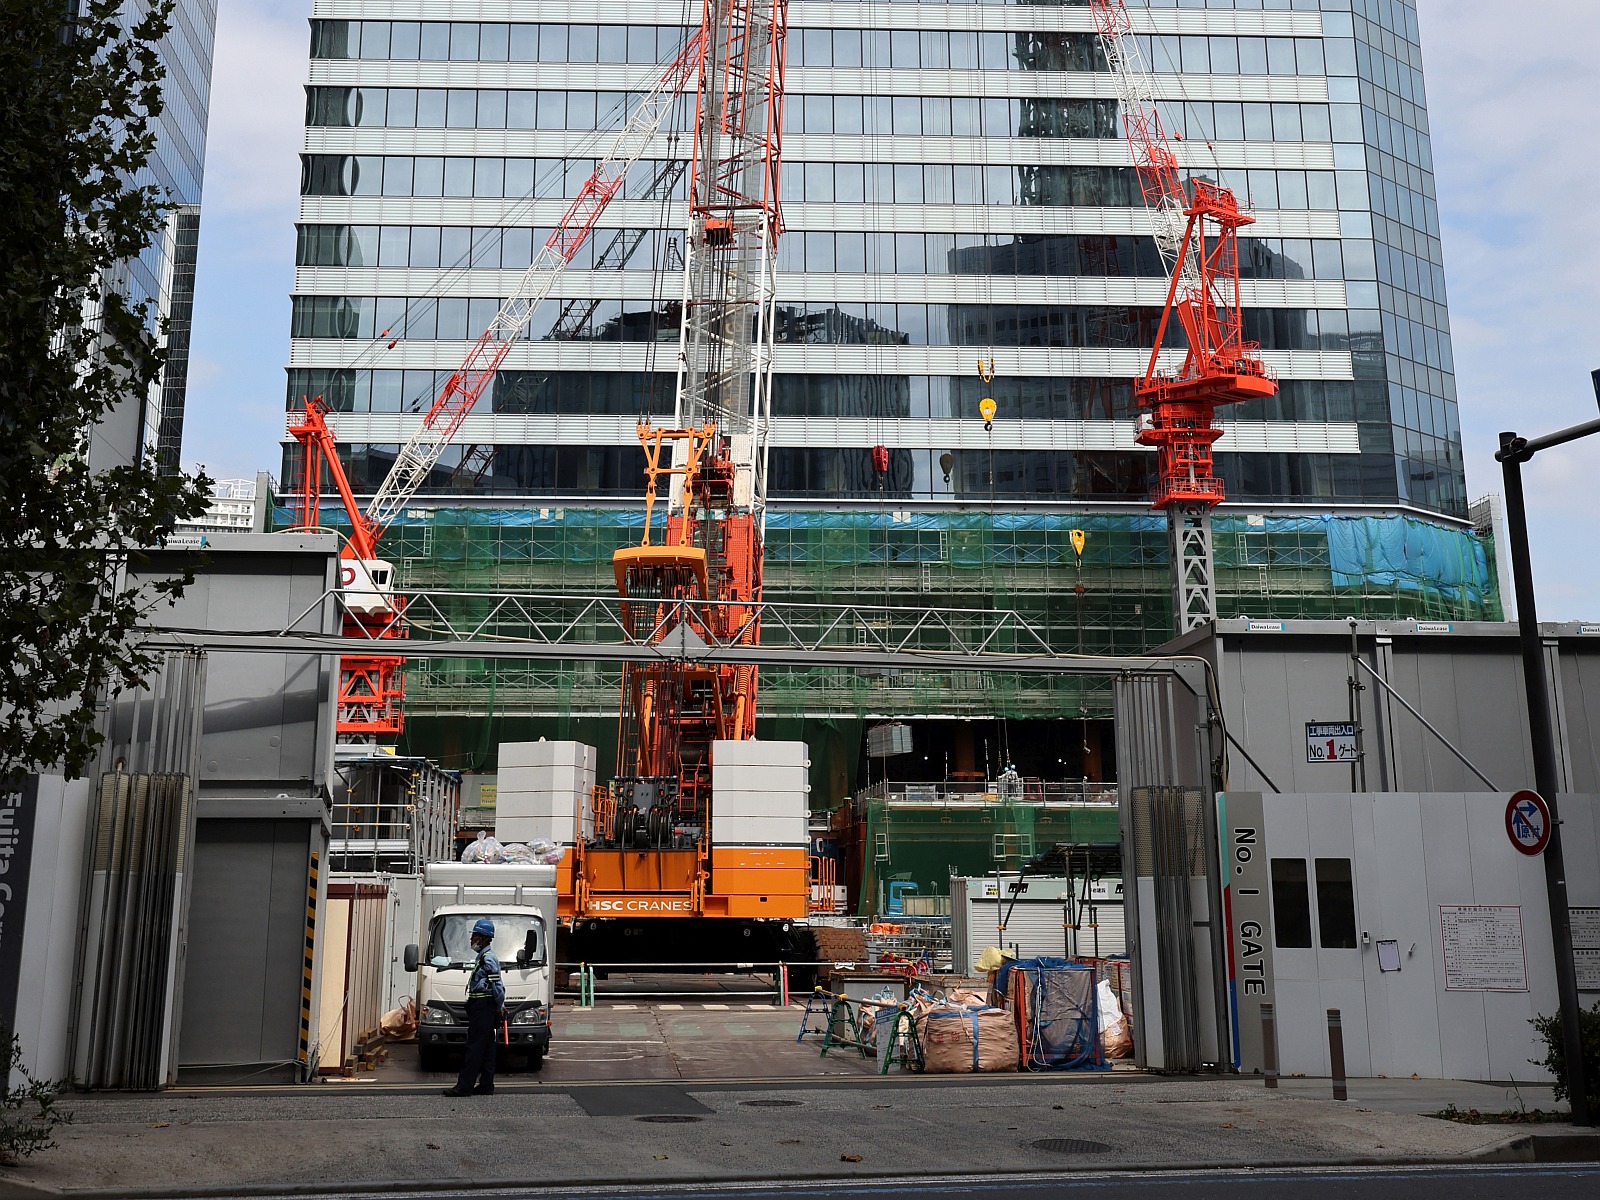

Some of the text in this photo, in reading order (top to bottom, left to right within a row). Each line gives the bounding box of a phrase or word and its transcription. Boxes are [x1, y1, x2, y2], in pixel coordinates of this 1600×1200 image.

[1309, 725, 1354, 736] 工事車両出入口
[1234, 828, 1256, 875] No.
[588, 901, 693, 910] HSC CRANES
[1240, 920, 1266, 995] GATE
